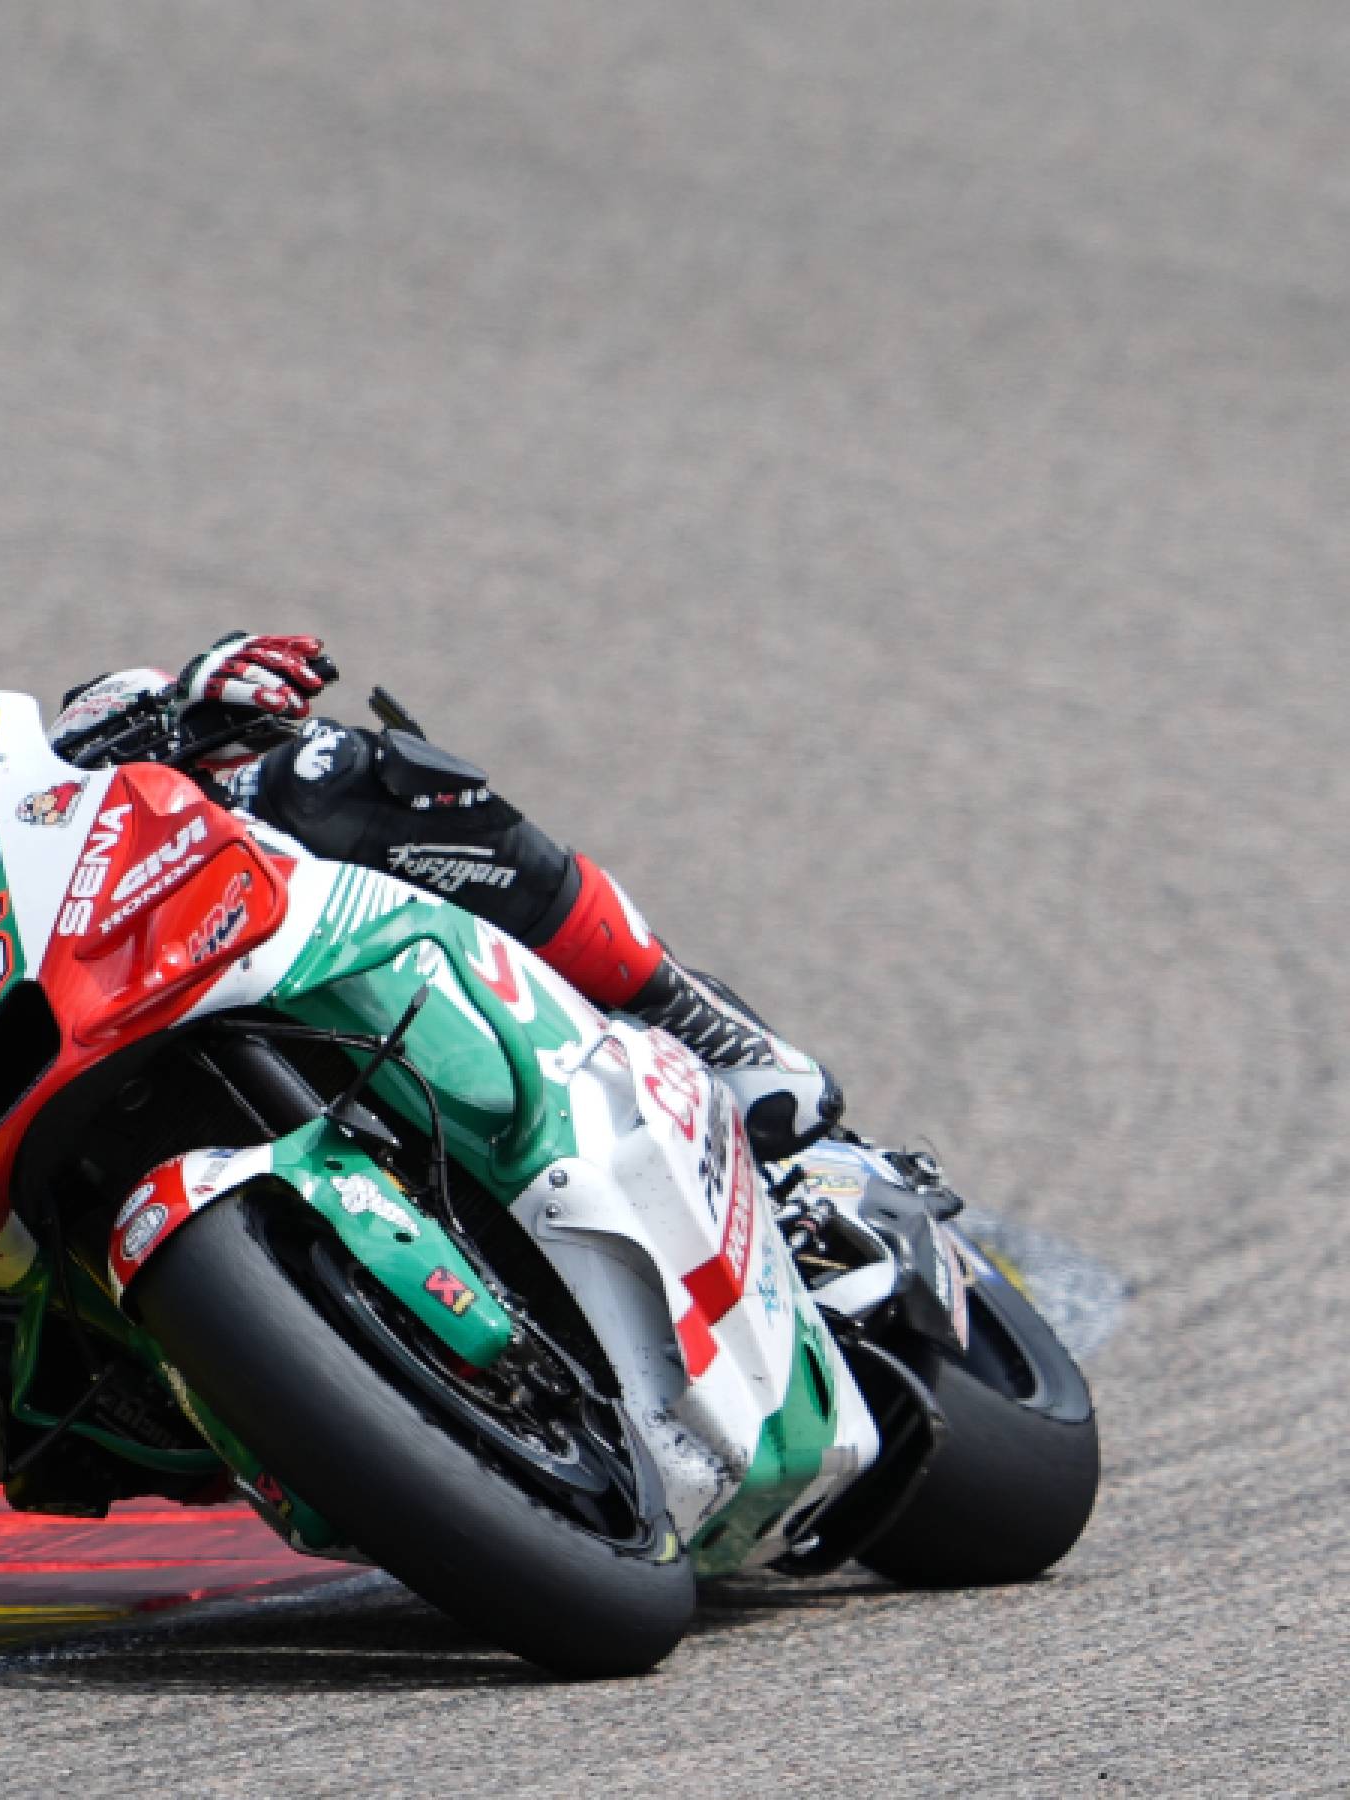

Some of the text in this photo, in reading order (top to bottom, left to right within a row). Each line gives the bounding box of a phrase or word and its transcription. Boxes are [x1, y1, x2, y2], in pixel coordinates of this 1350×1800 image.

[58, 803, 132, 936] SENA
[100, 854, 205, 932] HONDA
[112, 816, 207, 900] GIVI
